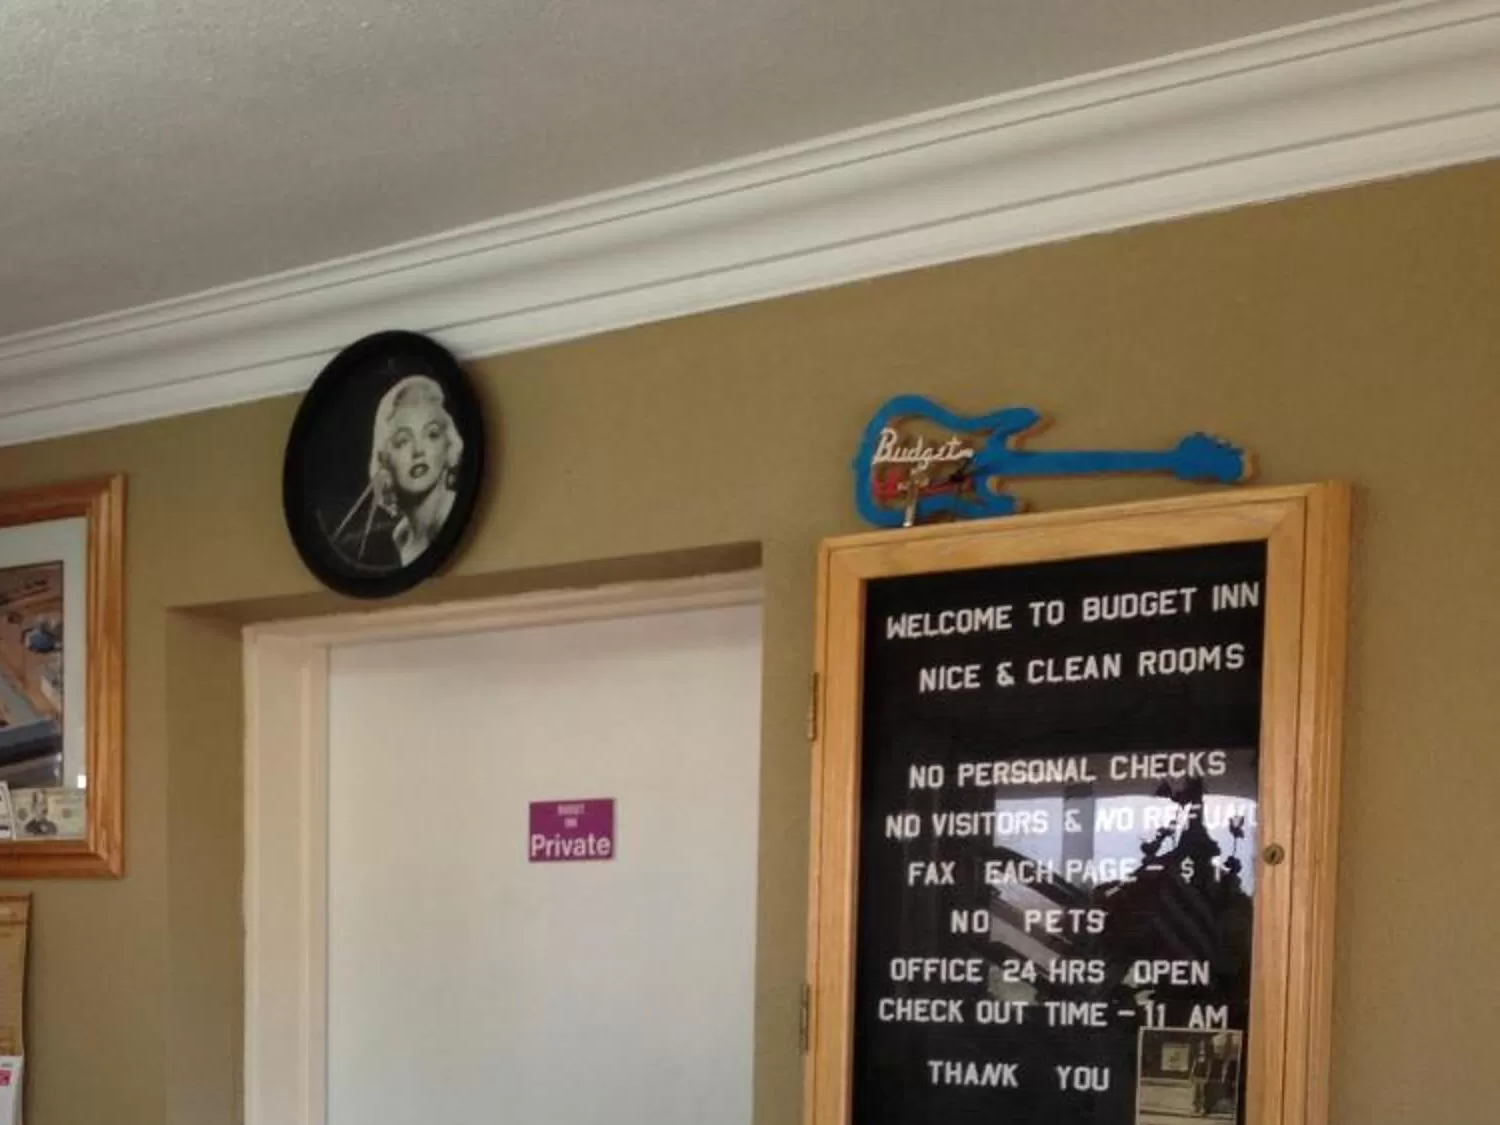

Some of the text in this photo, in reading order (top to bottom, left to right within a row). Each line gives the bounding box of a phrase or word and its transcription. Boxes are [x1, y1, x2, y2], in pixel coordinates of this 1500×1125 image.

[872, 427, 974, 470] Budget
[885, 581, 1260, 640] WELCOME TO BUDGET INN
[919, 643, 1245, 693] NICE & CLEAN ROOMS
[908, 751, 1227, 789] NO PERSONAL CHECKS
[885, 814, 921, 839] NO
[932, 809, 1050, 837] VISITORS
[1064, 808, 1082, 833] &
[1095, 806, 1133, 832] NO
[531, 832, 611, 858] Private
[908, 861, 956, 887] FAX
[984, 860, 1054, 886] EACH
[1065, 859, 1137, 886] PAGE
[950, 909, 1108, 934] NO PETS
[889, 957, 1211, 985] OFFICE 24 HRS OPEN
[878, 998, 965, 1023] CHECK
[976, 999, 1029, 1024] OUT
[1044, 1001, 1108, 1027] TIME
[1144, 1003, 1166, 1029] 11
[1187, 1004, 1228, 1030] AM
[927, 1060, 1111, 1091] THANK YOU
